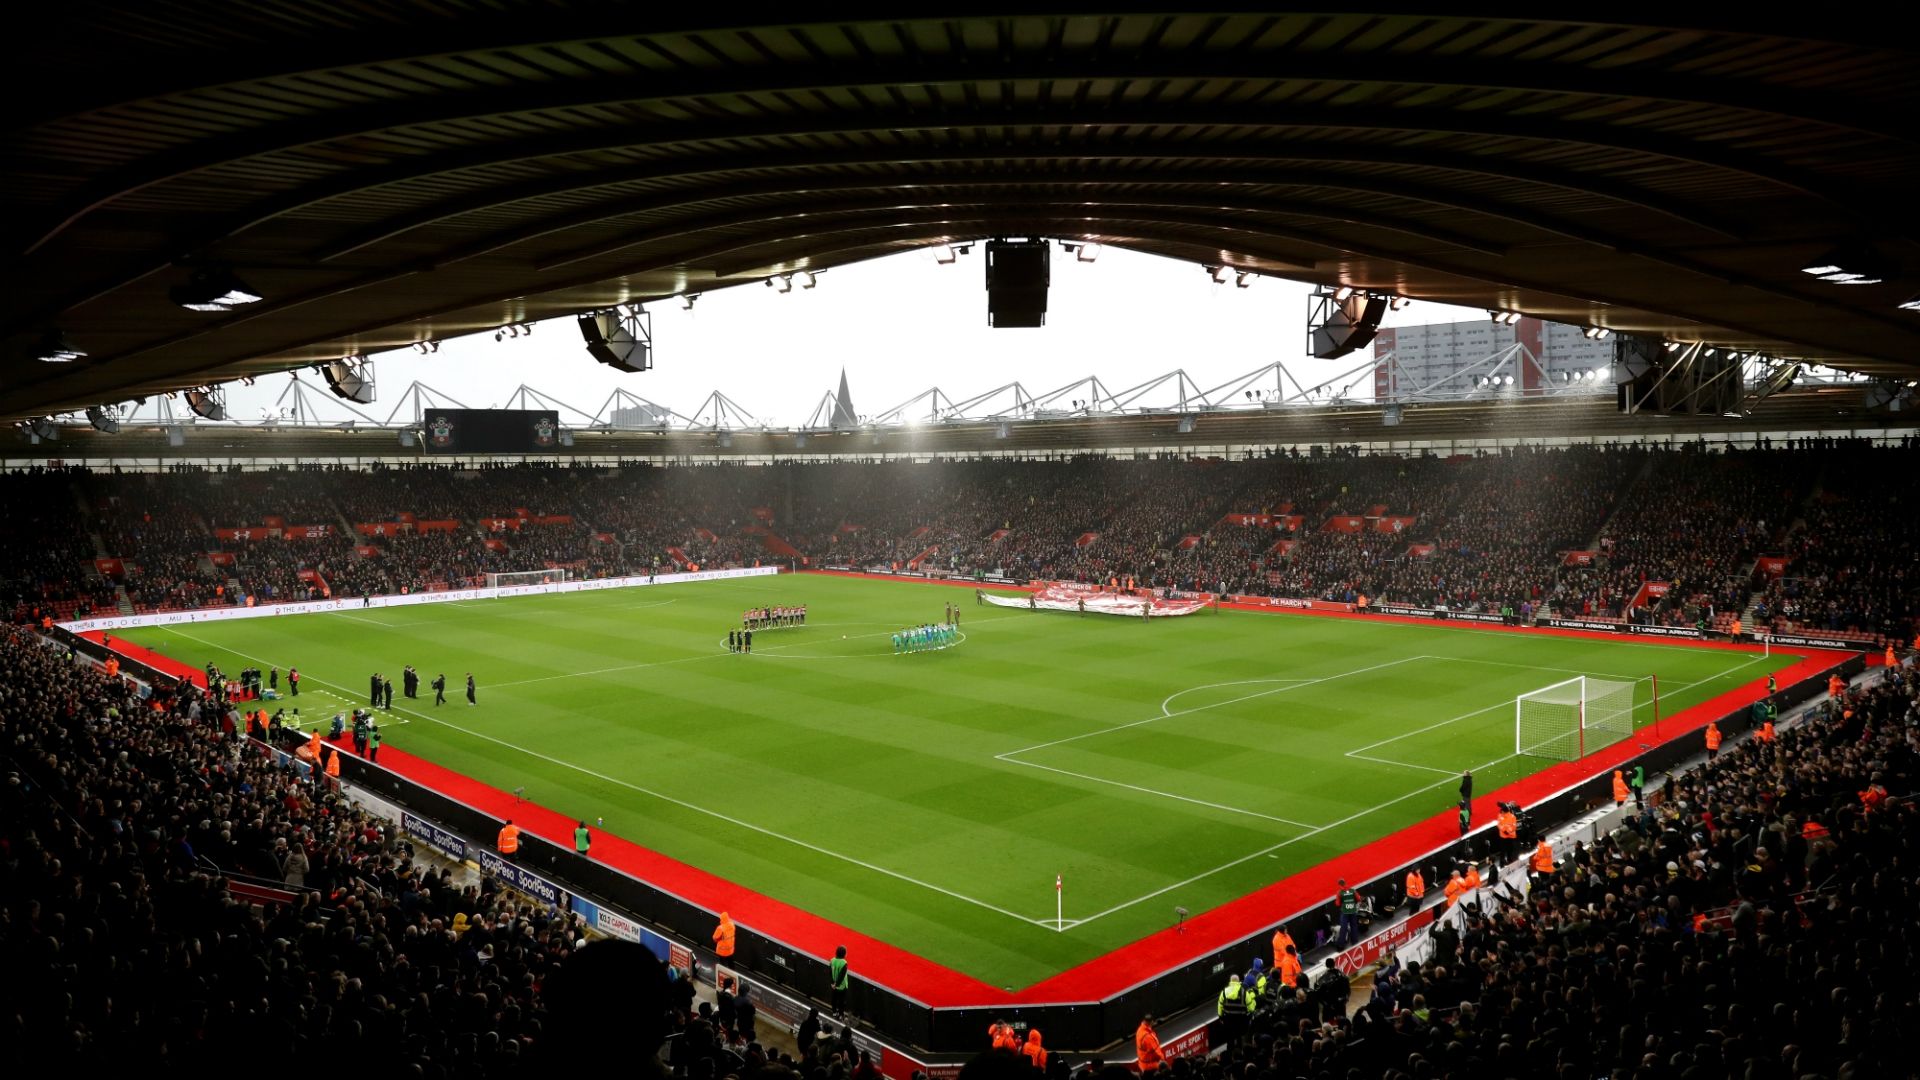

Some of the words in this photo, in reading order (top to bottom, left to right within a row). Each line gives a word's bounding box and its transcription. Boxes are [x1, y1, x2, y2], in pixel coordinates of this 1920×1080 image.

[1280, 599, 1302, 607] MARCH
[1584, 623, 1616, 631] ARMOUR
[1807, 640, 1846, 648] ARMOUR
[404, 814, 431, 839] SportPesa
[433, 829, 463, 856] SportPesa
[481, 852, 515, 881] SportPesa
[518, 870, 555, 901] SportPesa
[610, 917, 631, 933] CAPITAL
[1367, 940, 1378, 952] ALL
[1378, 932, 1390, 944] THE
[1390, 922, 1407, 940] SPORT
[1165, 1048, 1176, 1059] ALL
[1176, 1041, 1188, 1053] THE
[1188, 1032, 1205, 1046] SPORT
